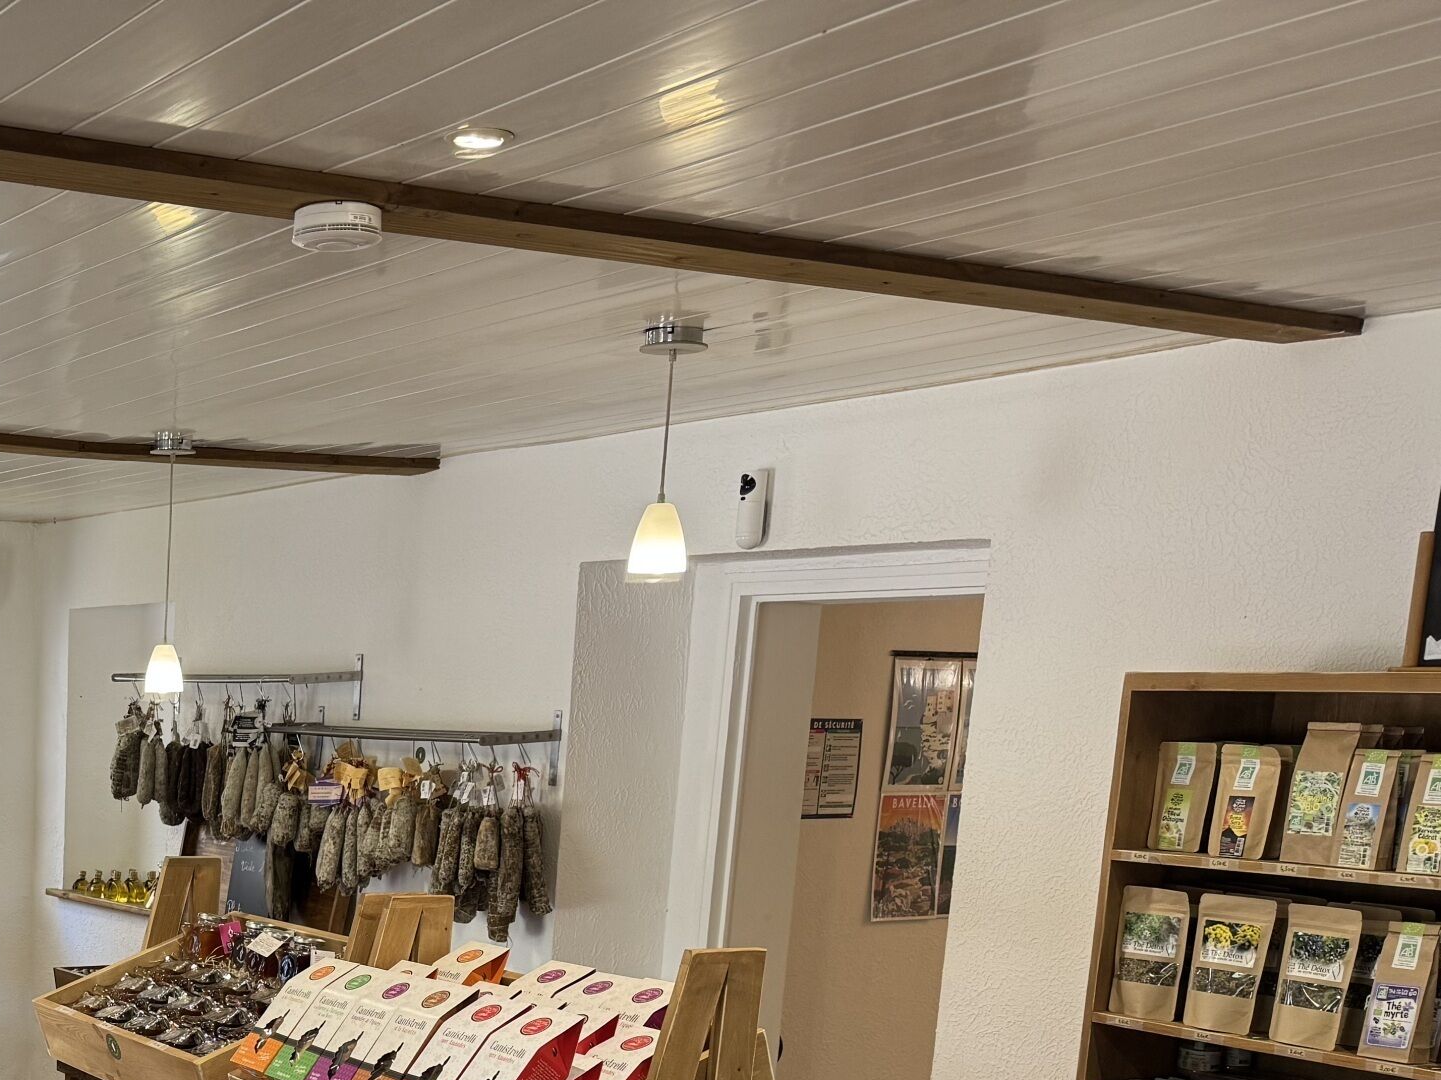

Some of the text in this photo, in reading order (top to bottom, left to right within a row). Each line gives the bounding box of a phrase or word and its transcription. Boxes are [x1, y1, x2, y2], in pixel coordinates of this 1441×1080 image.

[813, 720, 855, 730] DE SÉCURITÉ
[319, 995, 348, 1010] Canistrelli
[1386, 1001, 1402, 1011] Thé
[355, 1005, 386, 1020] Canistrelli
[1383, 1008, 1409, 1019] myrte
[395, 1014, 427, 1031] Canistrelli
[442, 1027, 478, 1044] Canistrelli
[490, 1040, 526, 1059] Canistrelli
